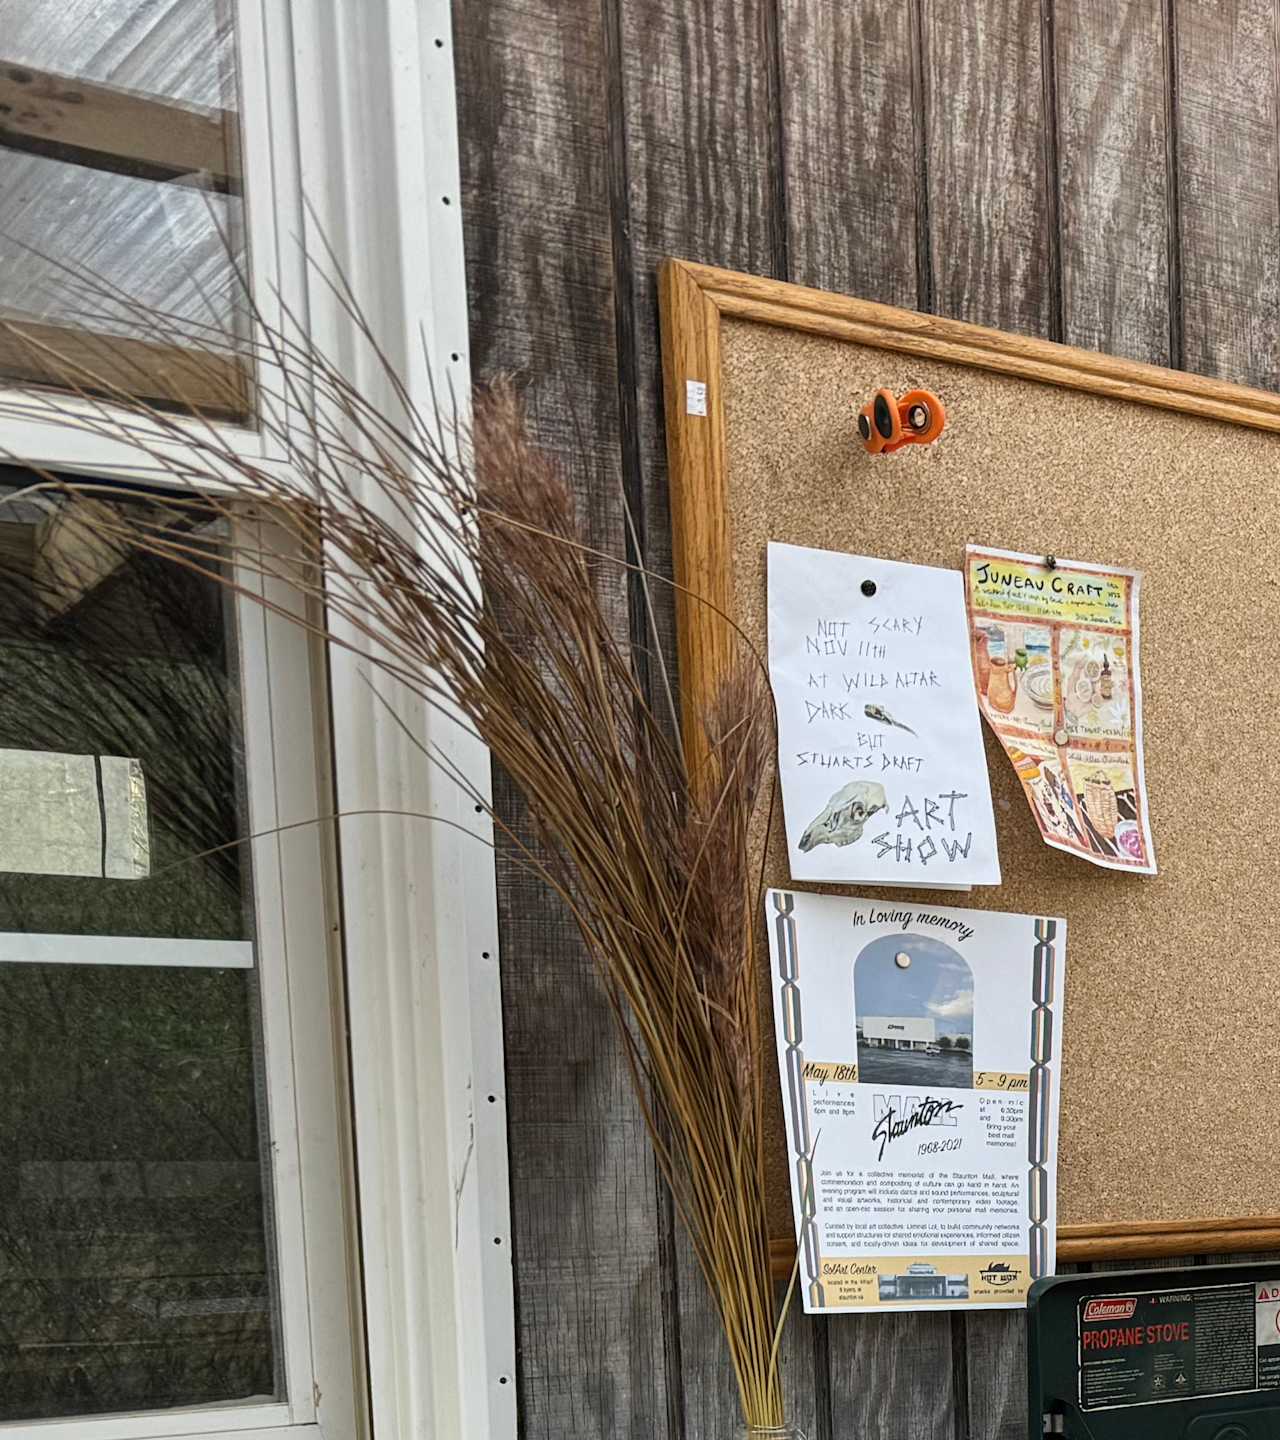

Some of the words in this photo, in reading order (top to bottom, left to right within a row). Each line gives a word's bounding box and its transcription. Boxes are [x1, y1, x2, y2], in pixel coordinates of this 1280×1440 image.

[976, 563, 1044, 591] JUNEAU
[1051, 577, 1103, 598] CRAFT
[817, 618, 850, 638] NOT
[868, 616, 923, 636] SCARY
[806, 635, 847, 656] NOV
[808, 673, 828, 689] AT
[842, 672, 888, 693] WILD
[895, 670, 941, 689] ALTAR
[805, 700, 852, 724] DARK
[857, 732, 885, 751] BUT
[796, 752, 873, 769] STUARTS
[881, 753, 924, 772] DRAFT
[895, 790, 969, 831] ART
[871, 832, 973, 866] SHOW
[853, 911, 865, 927] In
[869, 908, 913, 930] Loving
[916, 912, 975, 942] memory
[803, 1064, 828, 1086] May
[833, 1064, 857, 1080] 18th
[976, 1072, 985, 1086] 5
[997, 1074, 1006, 1087] 9
[1007, 1079, 1028, 1090] pm
[871, 1096, 964, 1162] Staunton
[1088, 1302, 1125, 1316] Coleman
[1083, 1326, 1144, 1350] PROPANE
[1146, 1322, 1190, 1345] STOVE
